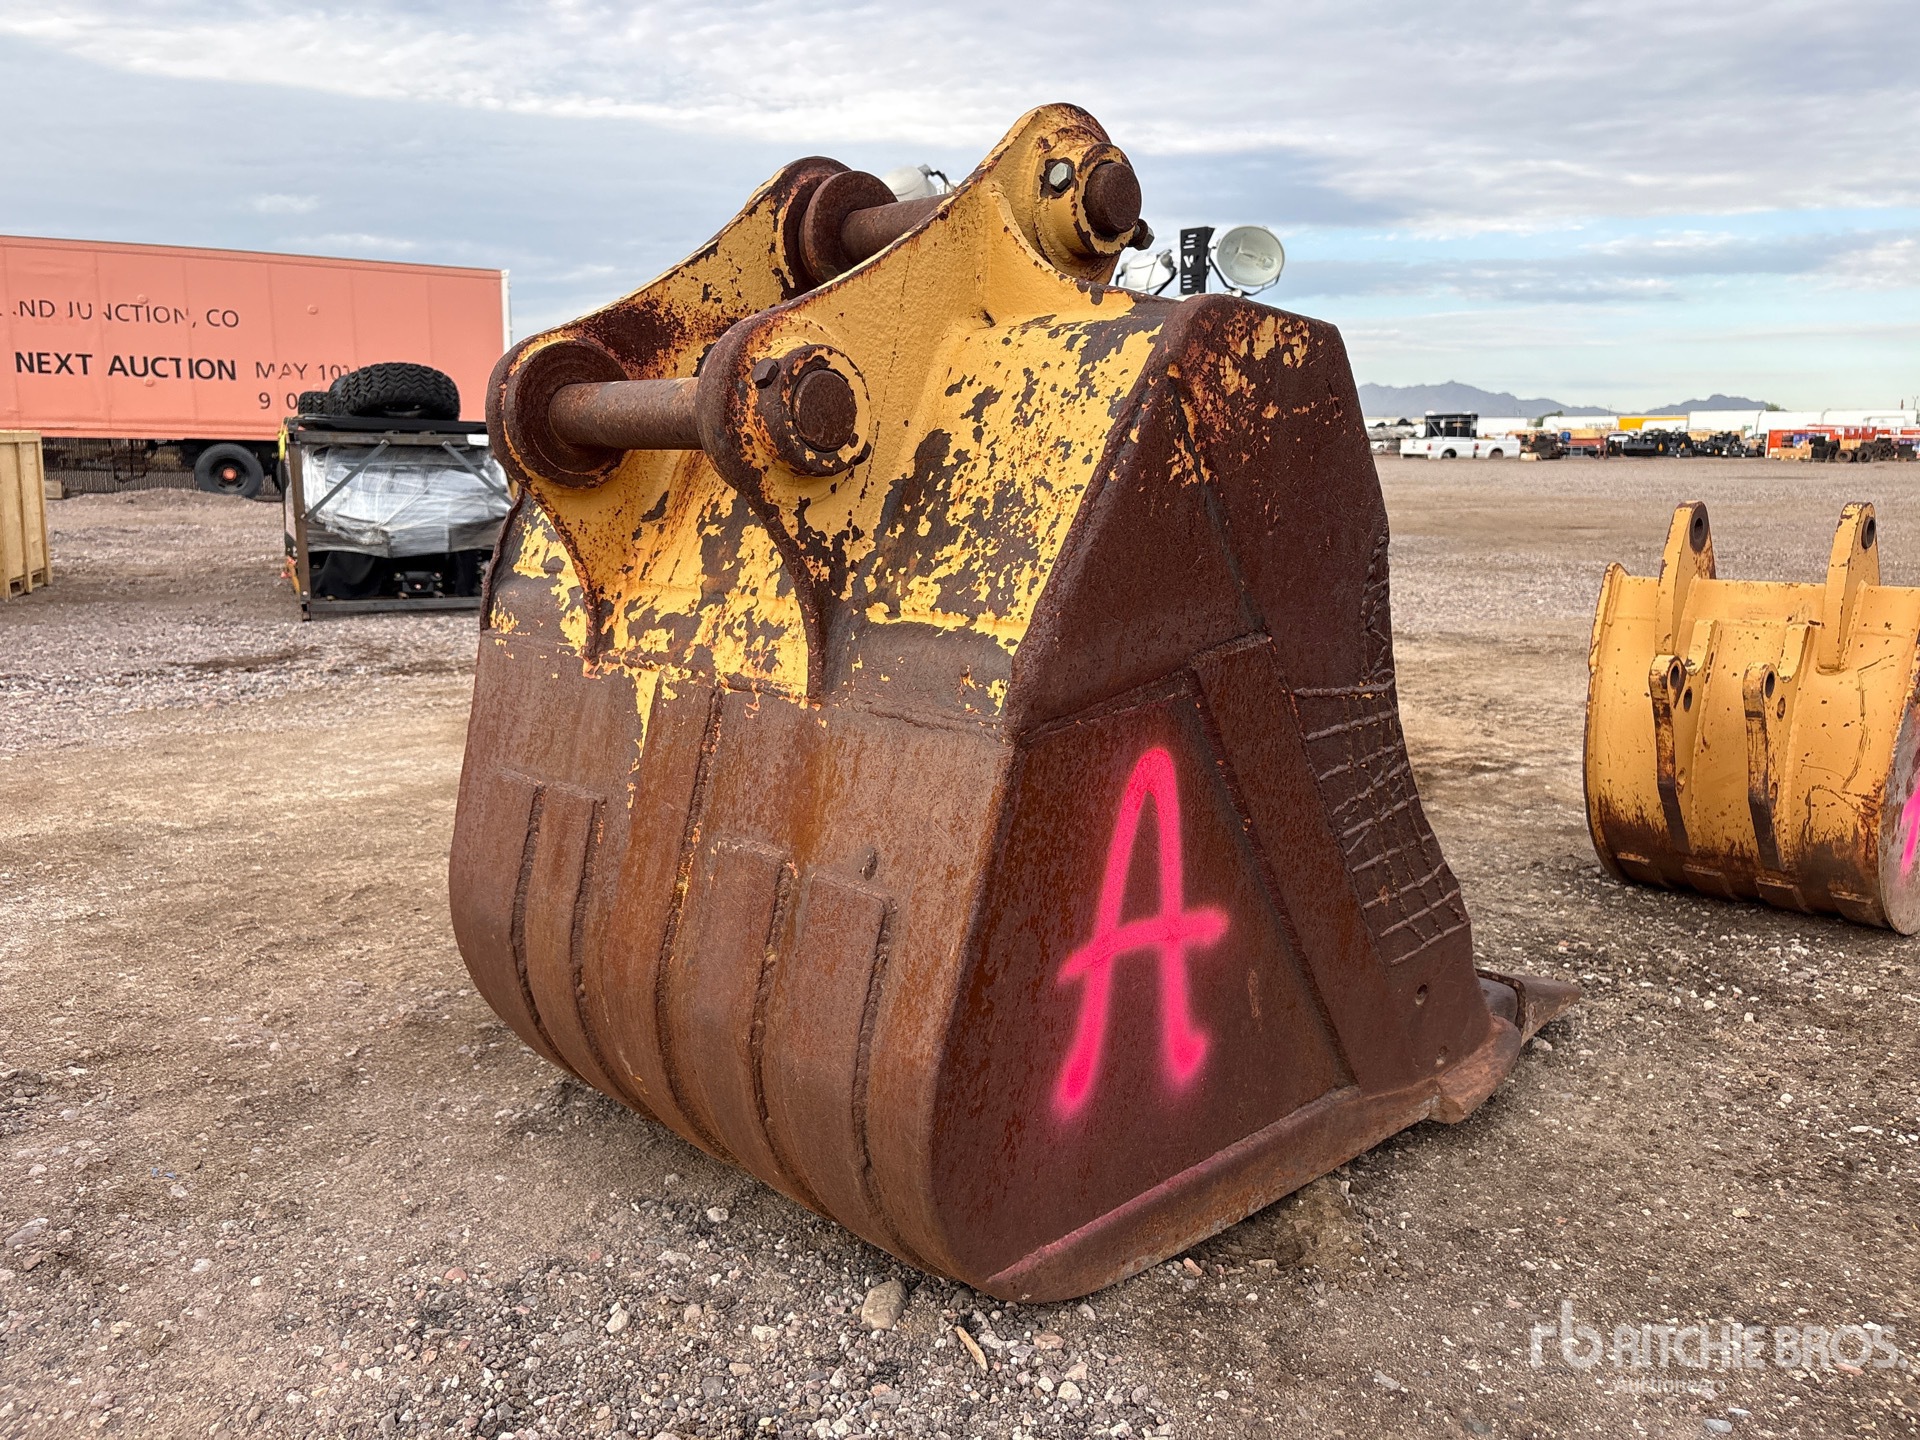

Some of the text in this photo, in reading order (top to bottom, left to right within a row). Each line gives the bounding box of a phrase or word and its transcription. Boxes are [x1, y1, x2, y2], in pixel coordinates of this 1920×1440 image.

[206, 309, 240, 328] CO
[15, 352, 93, 375] NEXT
[107, 355, 237, 381] AUCTION
[255, 361, 308, 381] MAY
[1053, 746, 1231, 1120] A
